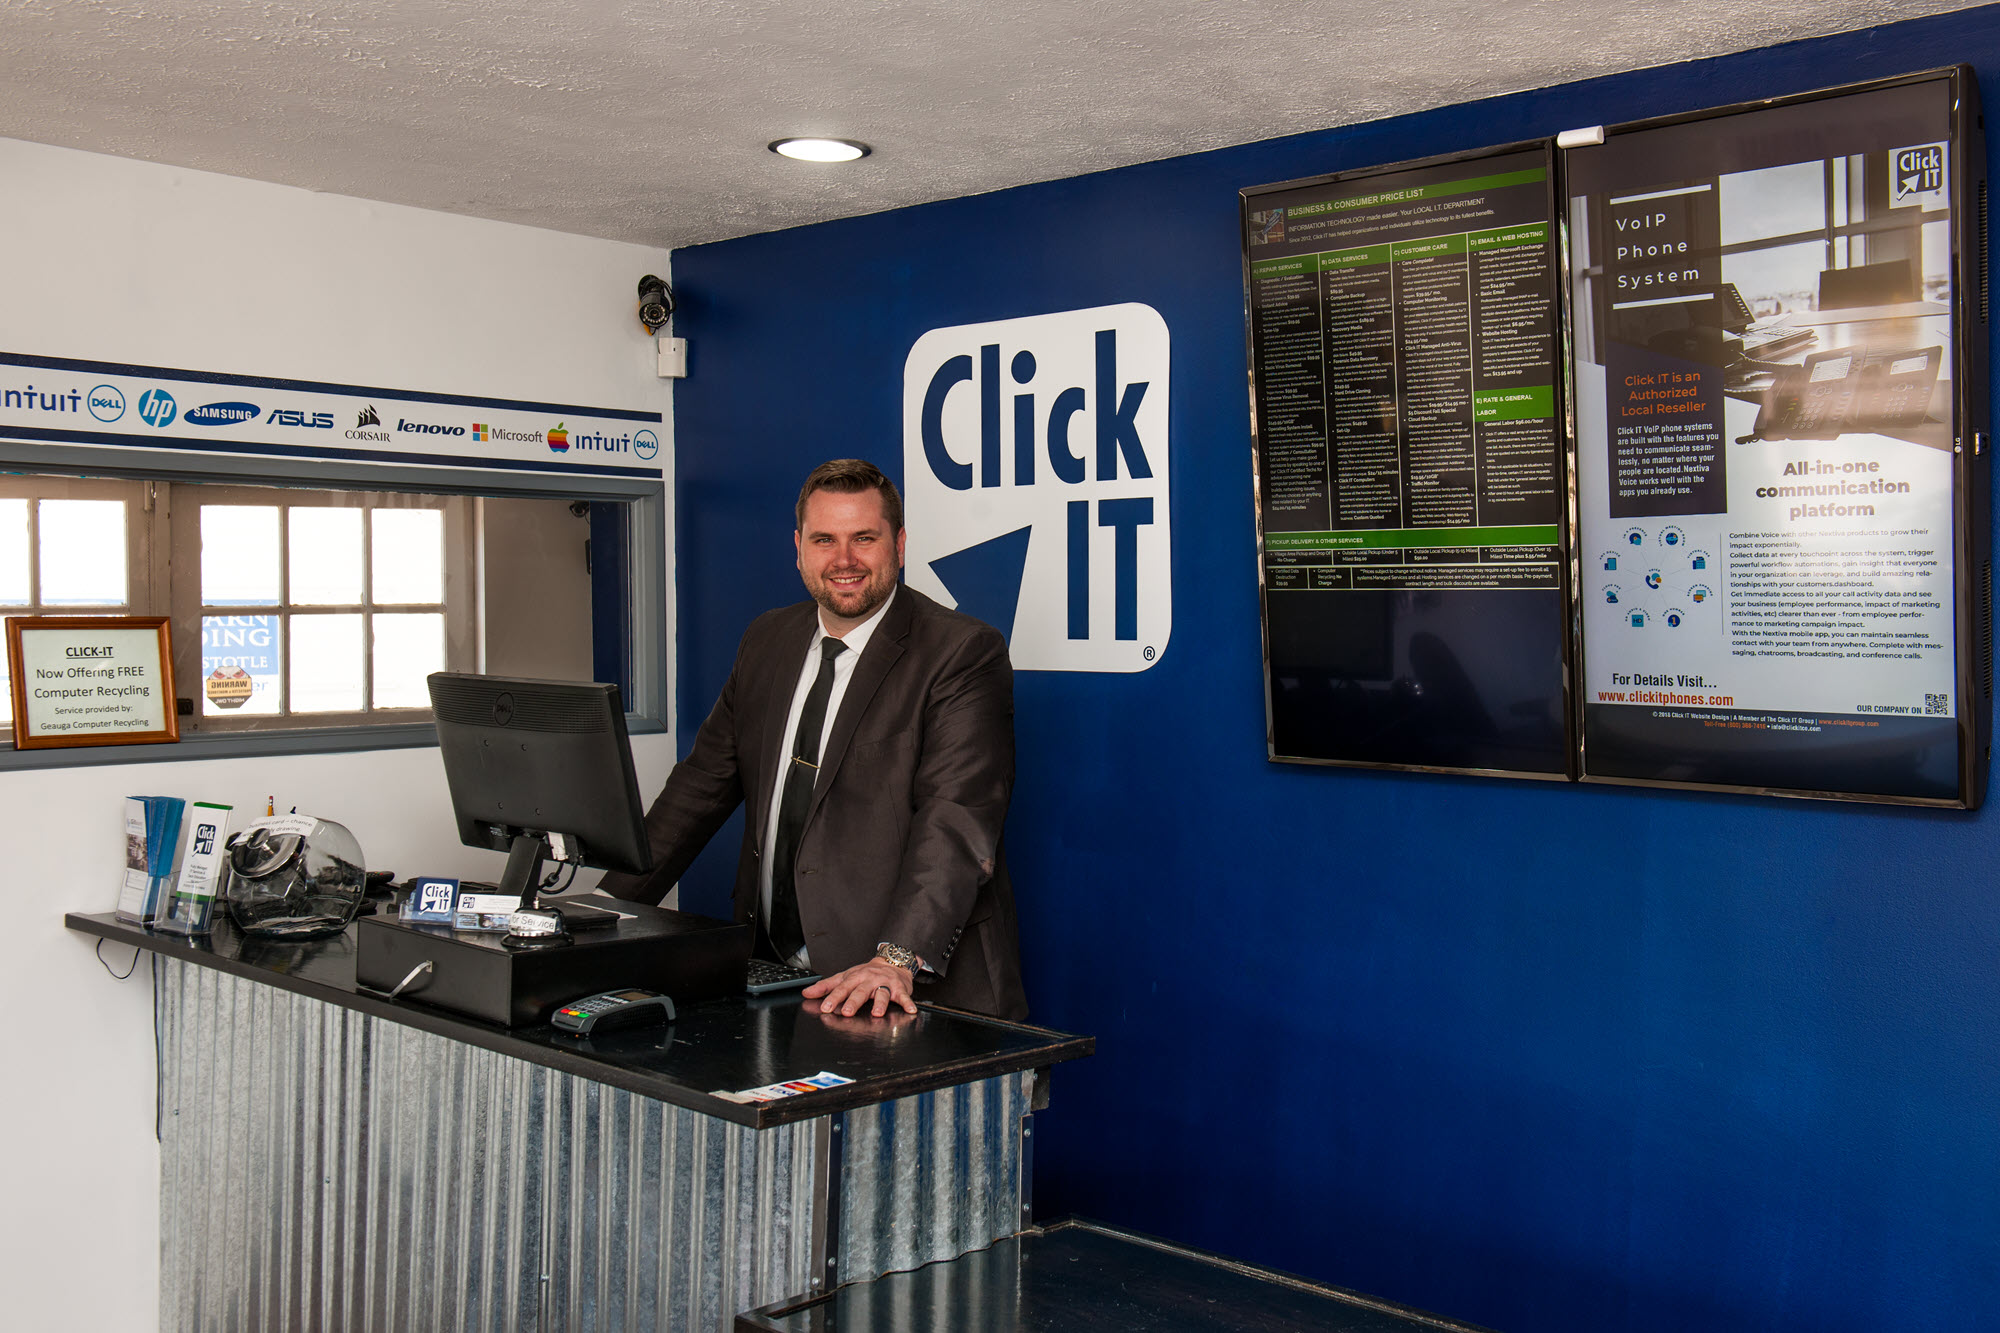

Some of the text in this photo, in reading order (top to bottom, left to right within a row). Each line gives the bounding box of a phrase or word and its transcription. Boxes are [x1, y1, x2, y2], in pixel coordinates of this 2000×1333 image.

[1900, 149, 1940, 172] Click
[1924, 168, 1940, 188] IT
[1288, 204, 1325, 216] BUSINESS
[1334, 196, 1378, 209] CONSUMER
[1380, 191, 1404, 202] PRICE
[1406, 189, 1424, 199] LIST
[1288, 222, 1325, 232] INFORMATION
[1328, 216, 1365, 227] TECHNOLOGY
[1382, 211, 1399, 219] easier.
[1413, 206, 1432, 214] LOCAL
[1443, 198, 1485, 210] DEPARTMENT
[1616, 213, 1667, 231] VoIP
[1478, 237, 1495, 245] EMAIL
[1502, 234, 1516, 242] WEB
[1516, 230, 1544, 239] HOSTING
[1401, 245, 1431, 255] CUSTOMER
[1617, 239, 1688, 260] Phone
[1343, 254, 1368, 263] SERVICES
[1278, 263, 1302, 271] SERVICES
[1618, 266, 1699, 290] System
[1625, 372, 1701, 386] Click IT is an
[0, 385, 81, 412] ntuit
[1505, 394, 1533, 402] GENERAL
[1629, 386, 1697, 400] Authorized
[91, 397, 122, 410] DELL
[143, 388, 174, 428] hp
[921, 329, 1154, 491] Click
[1622, 401, 1706, 416] Local Reseller
[193, 406, 252, 421] SAMSUNG
[266, 409, 334, 429] ASUS
[397, 418, 466, 437] lenovo
[1617, 423, 1713, 435] Click IT VoIP phone systems
[345, 429, 391, 443] CORSAIR
[492, 428, 543, 443] Microsoft
[576, 431, 630, 453] intuit
[1630, 436, 1646, 445] built
[1647, 435, 1662, 443] with
[1676, 433, 1705, 442] features
[1706, 433, 1719, 442] you
[1954, 436, 1961, 448] LG
[1617, 444, 1714, 455] need to communicate seam-
[1652, 456, 1674, 464] matter
[1698, 454, 1715, 463] your
[1618, 467, 1641, 477] people
[1783, 459, 1880, 477] All-in-one
[1619, 478, 1638, 486] Voice
[1639, 477, 1659, 485] works
[1661, 476, 1675, 484] well
[1619, 489, 1635, 497] apps
[1637, 488, 1649, 497] you
[1650, 486, 1676, 495] already
[1756, 479, 1911, 499] communication
[1789, 502, 1875, 522] platform
[1067, 497, 1154, 641] IT
[1749, 629, 1761, 637] the
[1789, 630, 1814, 638] mobile
[1815, 631, 1830, 639] app,
[1831, 631, 1845, 639] you
[1895, 631, 1929, 639] seamless
[65, 646, 114, 658] CLICK-IT
[1732, 649, 1757, 657] saging,
[1758, 649, 1796, 658] chatrooms,
[1797, 650, 1845, 659] broadcasting,
[1862, 651, 1903, 659] conference
[1904, 652, 1923, 660] calls.
[36, 666, 145, 680] Now Offering FREE
[1612, 673, 1717, 688] For Details Visit...
[34, 684, 150, 701] Computer Recycling
[1598, 690, 1734, 706] www.clickitphones.com
[54, 704, 134, 716] Service provided by:
[1857, 704, 1922, 714] OUR COMPANY ON
[40, 718, 149, 732] Geauga Computer Recycling
[197, 825, 215, 840] Click
[204, 840, 213, 853] IT
[425, 885, 449, 898] Click
[438, 898, 449, 910] IT
